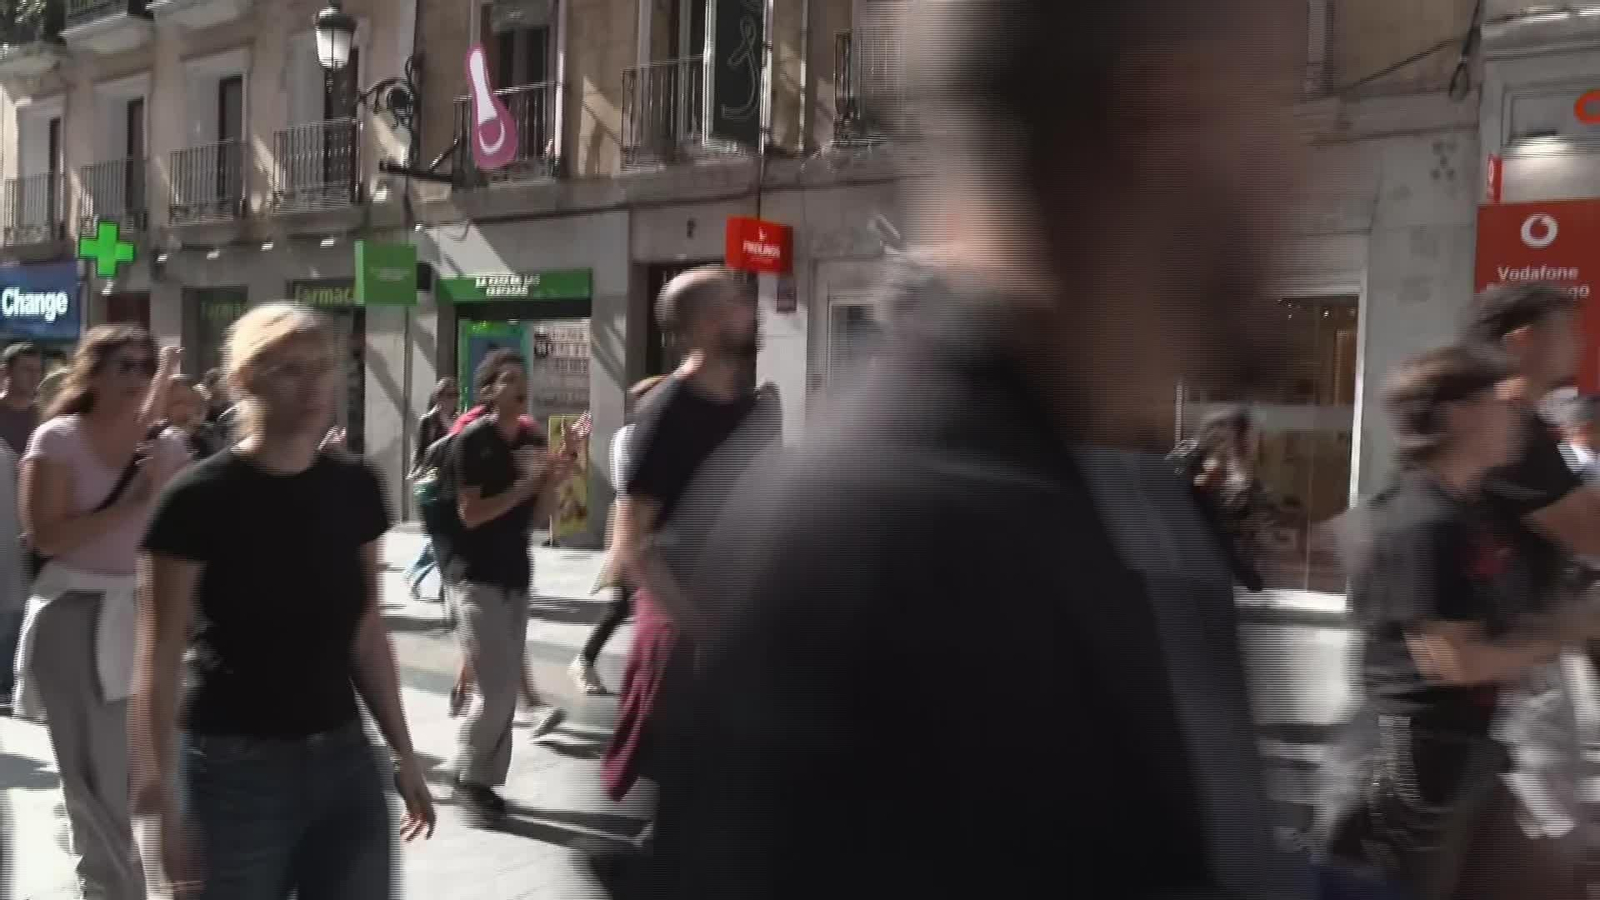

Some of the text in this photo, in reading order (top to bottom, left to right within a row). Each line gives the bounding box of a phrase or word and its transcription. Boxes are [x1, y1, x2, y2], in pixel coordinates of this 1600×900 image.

[1497, 264, 1580, 281] Vodafone
[1, 287, 70, 323] Change
[294, 285, 354, 306] Farmac
